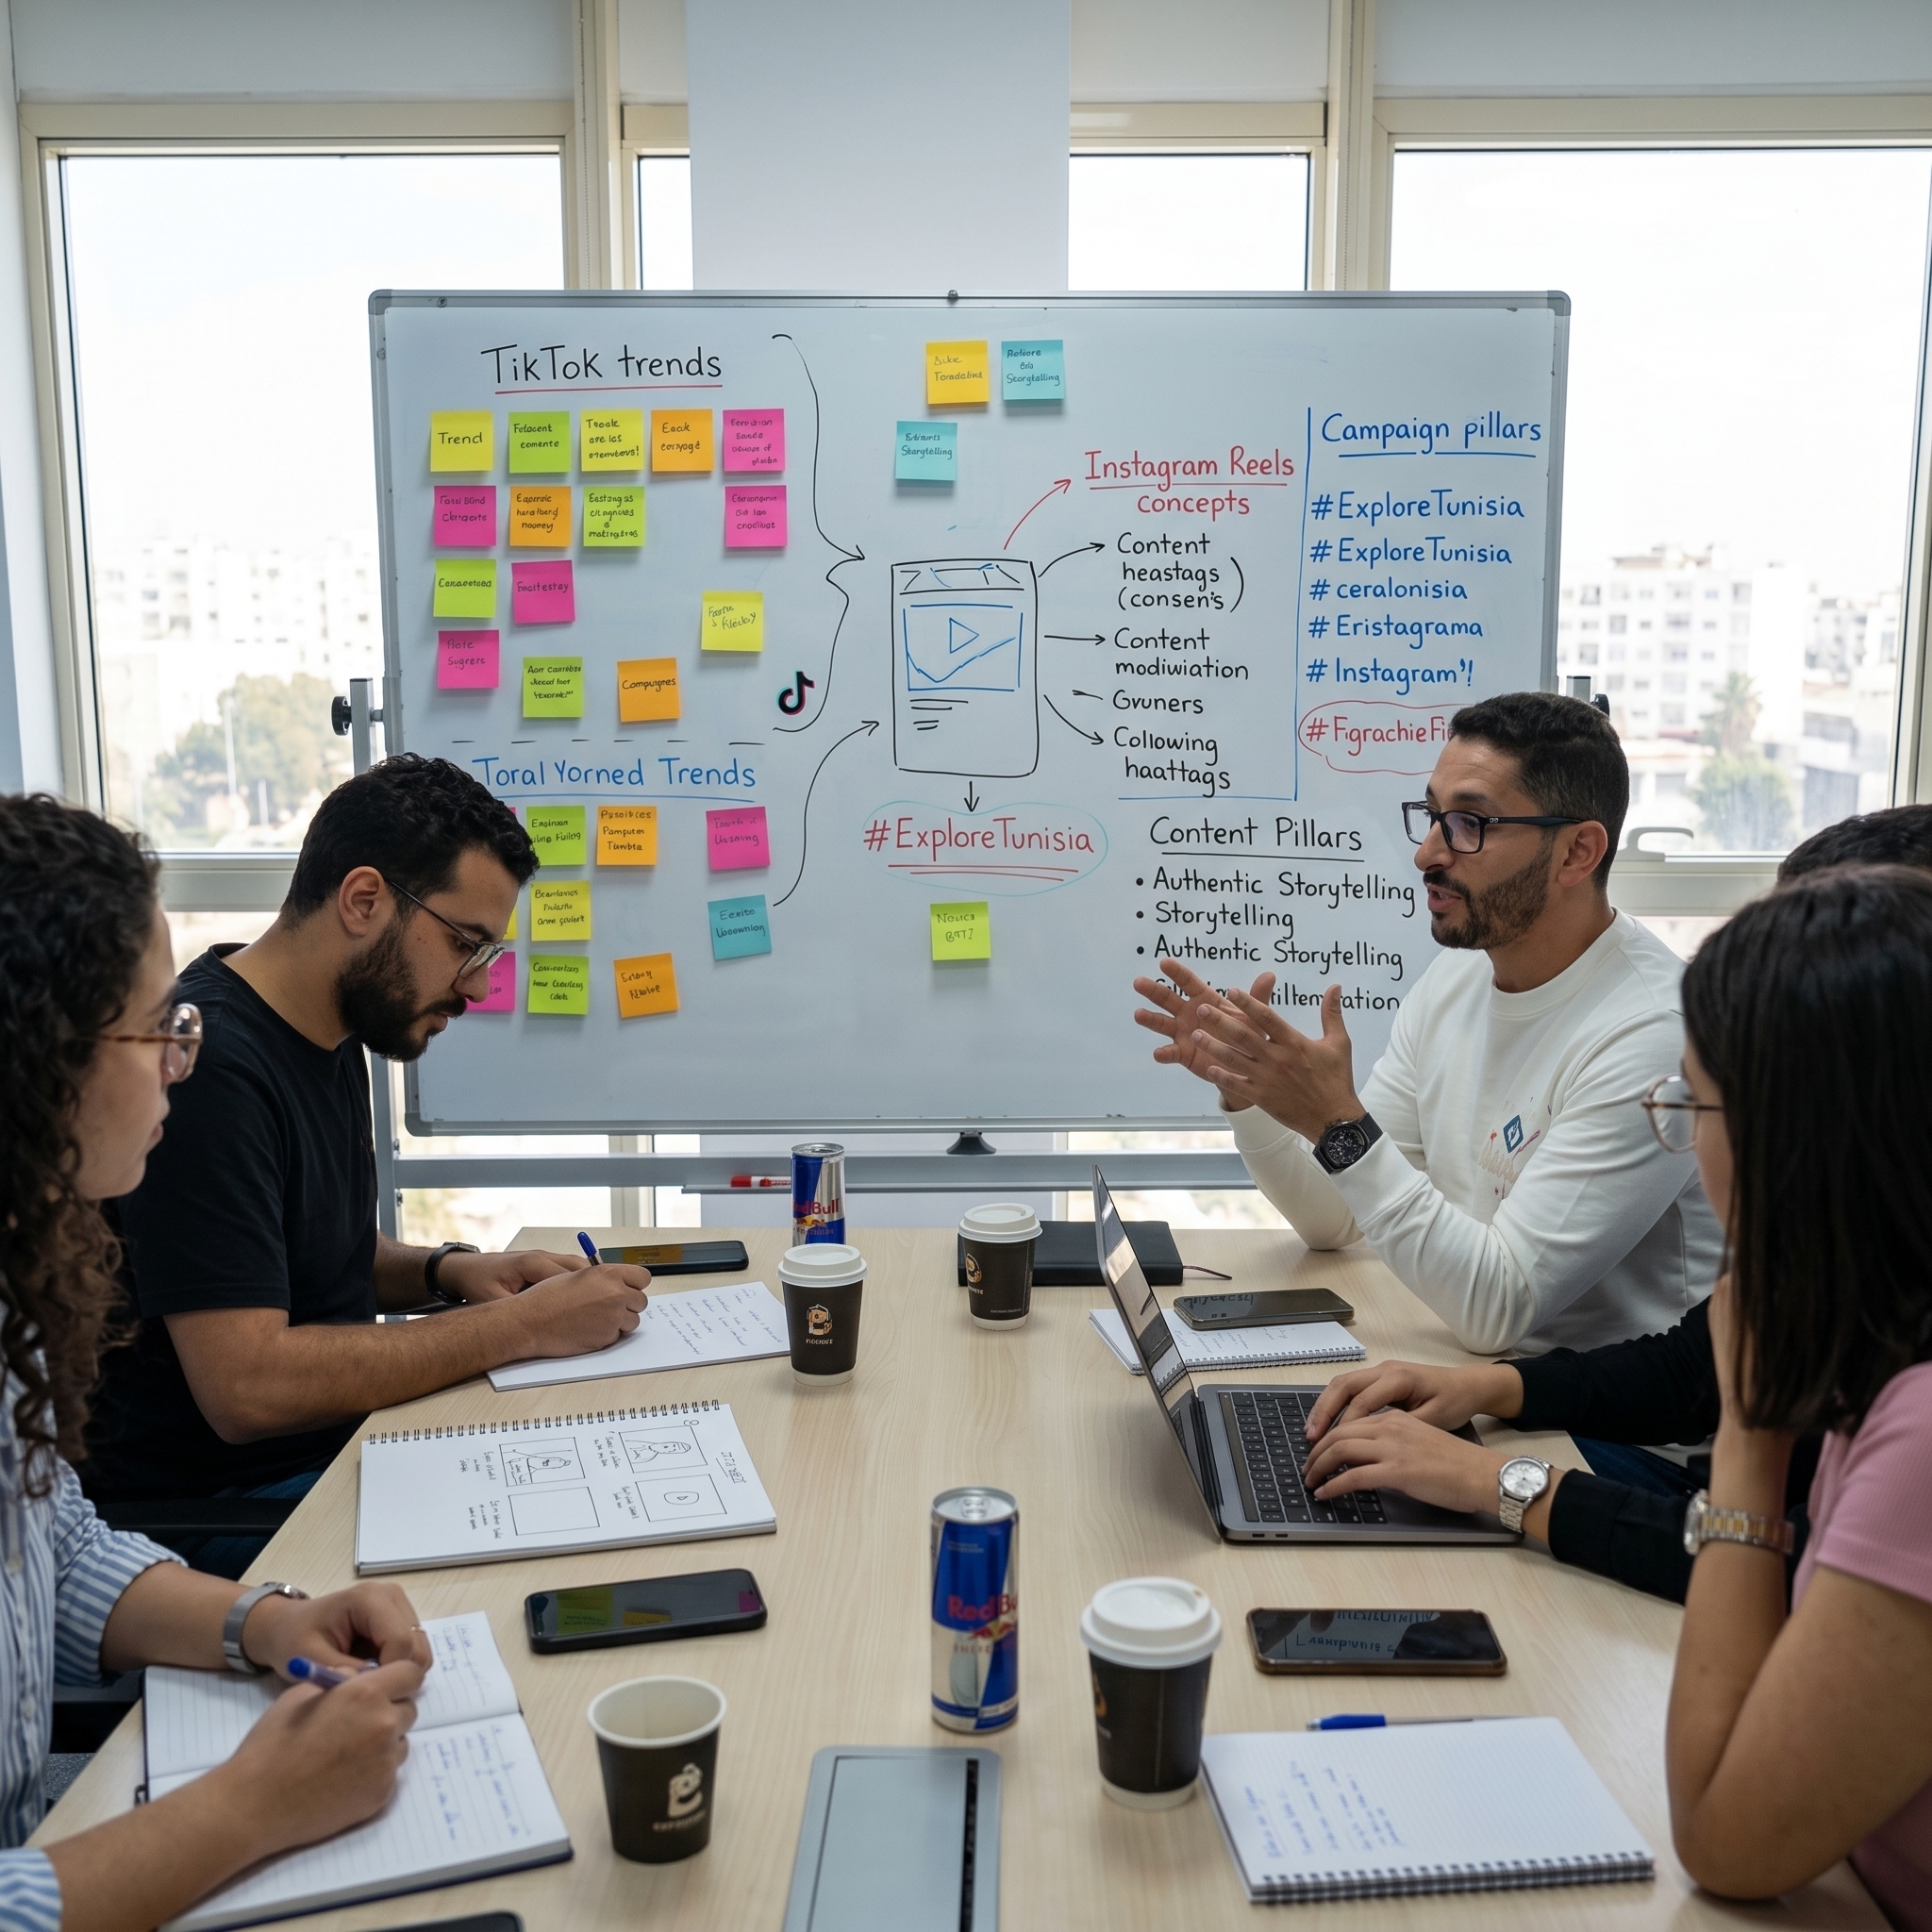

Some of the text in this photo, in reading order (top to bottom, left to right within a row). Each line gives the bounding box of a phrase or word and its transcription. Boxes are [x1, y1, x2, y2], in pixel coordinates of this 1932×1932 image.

[481, 344, 722, 383] TikTok trends
[438, 432, 483, 444] Trend
[1322, 410, 1541, 454] Campaign pillars
[1085, 445, 1294, 491] Instagram Reels
[1311, 489, 1524, 526] #ExploreTunisia
[1117, 532, 1210, 555] Content
[1309, 536, 1512, 570] #ExploreTunisia
[1123, 560, 1220, 591] heastags
[1114, 627, 1209, 650] Content
[1115, 656, 1248, 680] modiwiation
[1114, 726, 1218, 766] Collowing
[472, 758, 756, 788] Toral Yorned Trends
[1125, 756, 1230, 798] haattags
[863, 817, 1094, 861] #ExploreTunisia
[1150, 816, 1362, 851] Content Pillars
[1153, 866, 1414, 918] Authentic Storytelling
[1156, 901, 1294, 940] Storytelling
[1155, 934, 1403, 981] Authentic Storytelling
[811, 1198, 840, 1214] Bull
